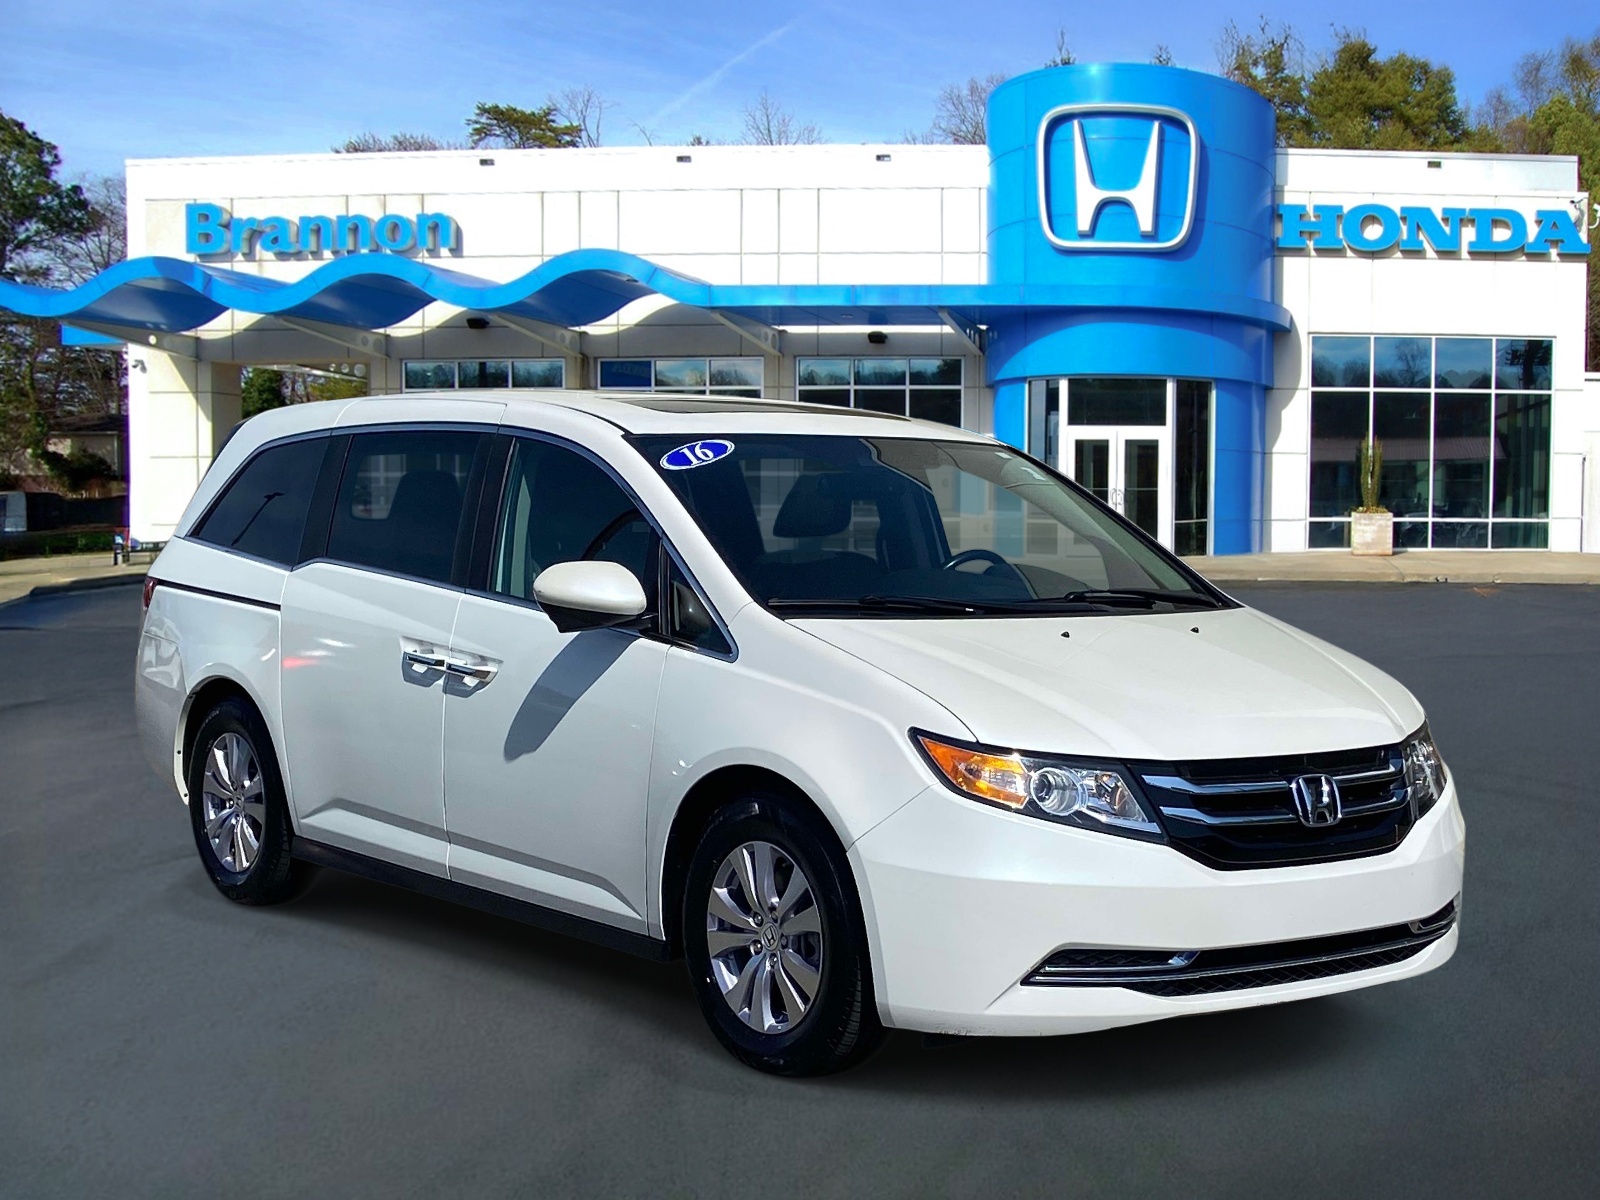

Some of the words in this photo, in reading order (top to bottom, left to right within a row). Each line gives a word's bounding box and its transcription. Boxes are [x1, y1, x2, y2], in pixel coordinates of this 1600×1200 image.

[185, 202, 460, 258] Brannon
[1276, 203, 1592, 254] HONDA
[678, 441, 714, 466] 16
